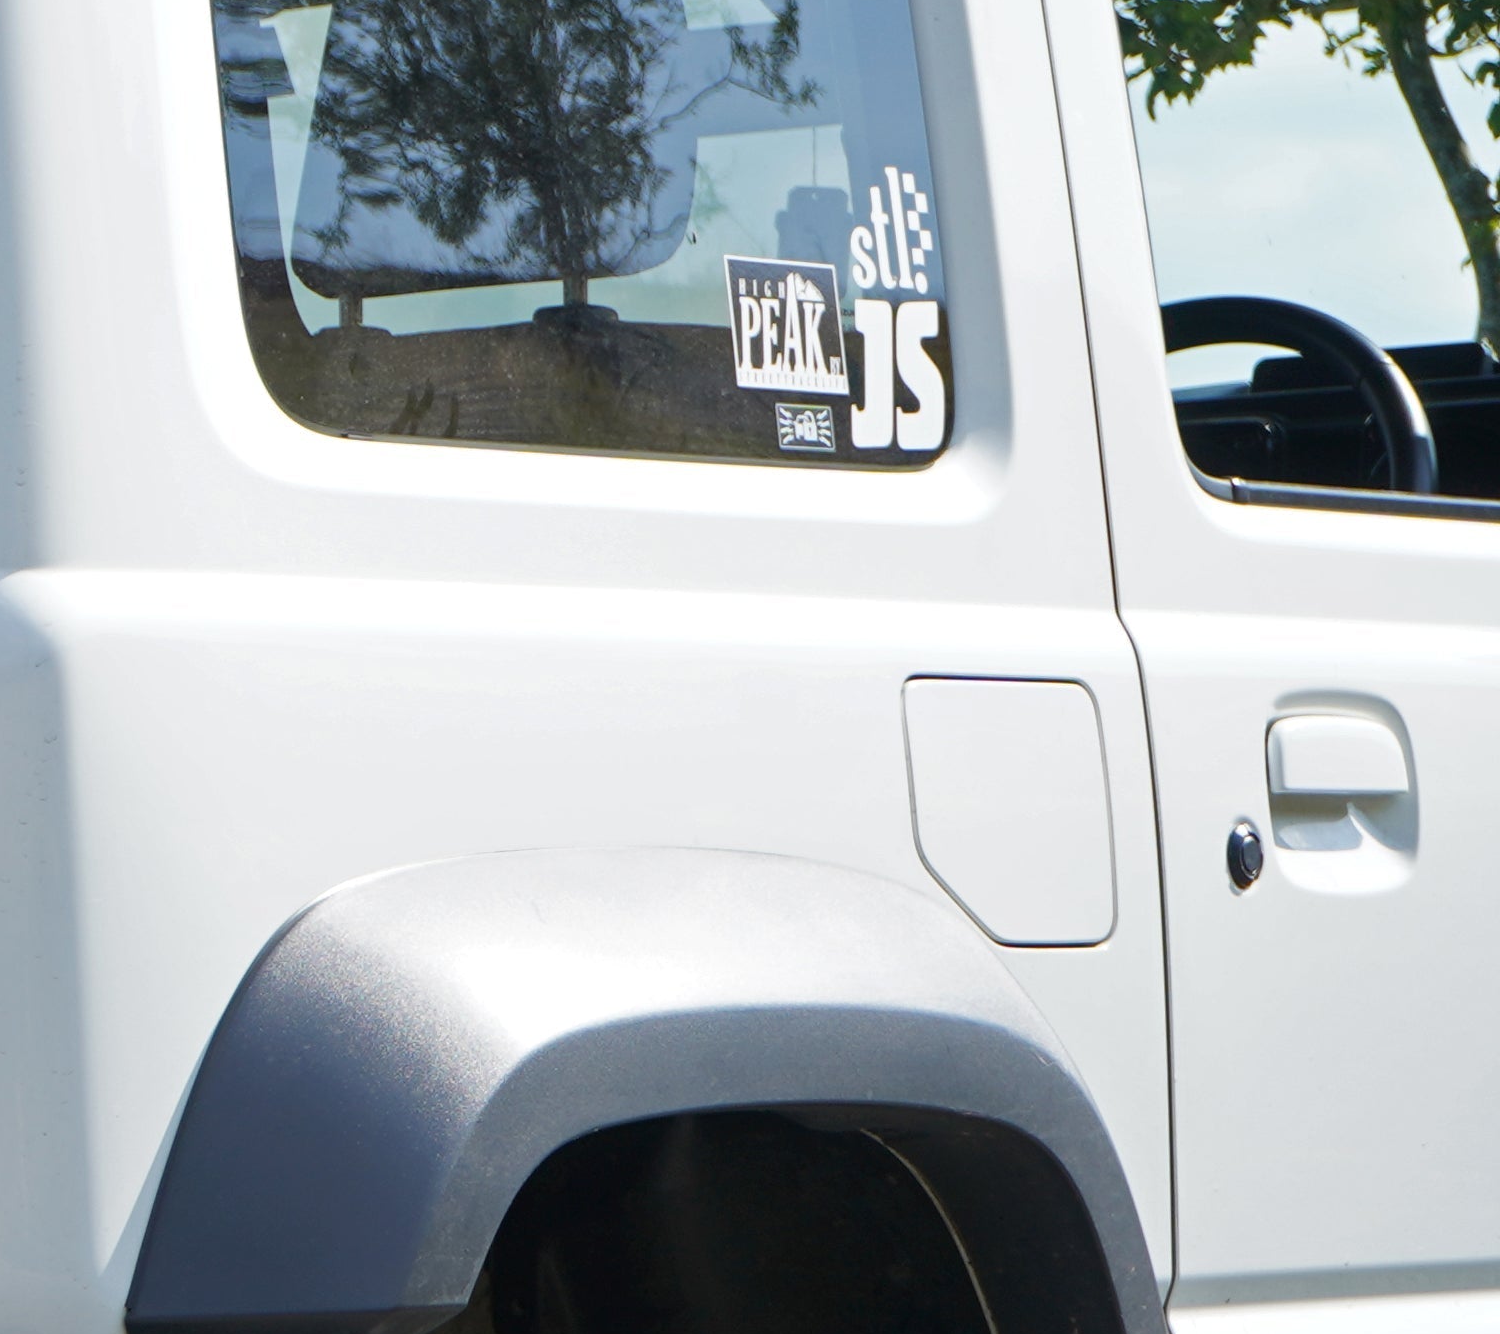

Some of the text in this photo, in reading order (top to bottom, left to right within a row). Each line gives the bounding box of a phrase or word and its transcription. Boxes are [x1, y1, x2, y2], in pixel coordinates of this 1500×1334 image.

[738, 277, 786, 299] HIGH
[739, 272, 829, 377] PEAK
[850, 299, 947, 451] JS
